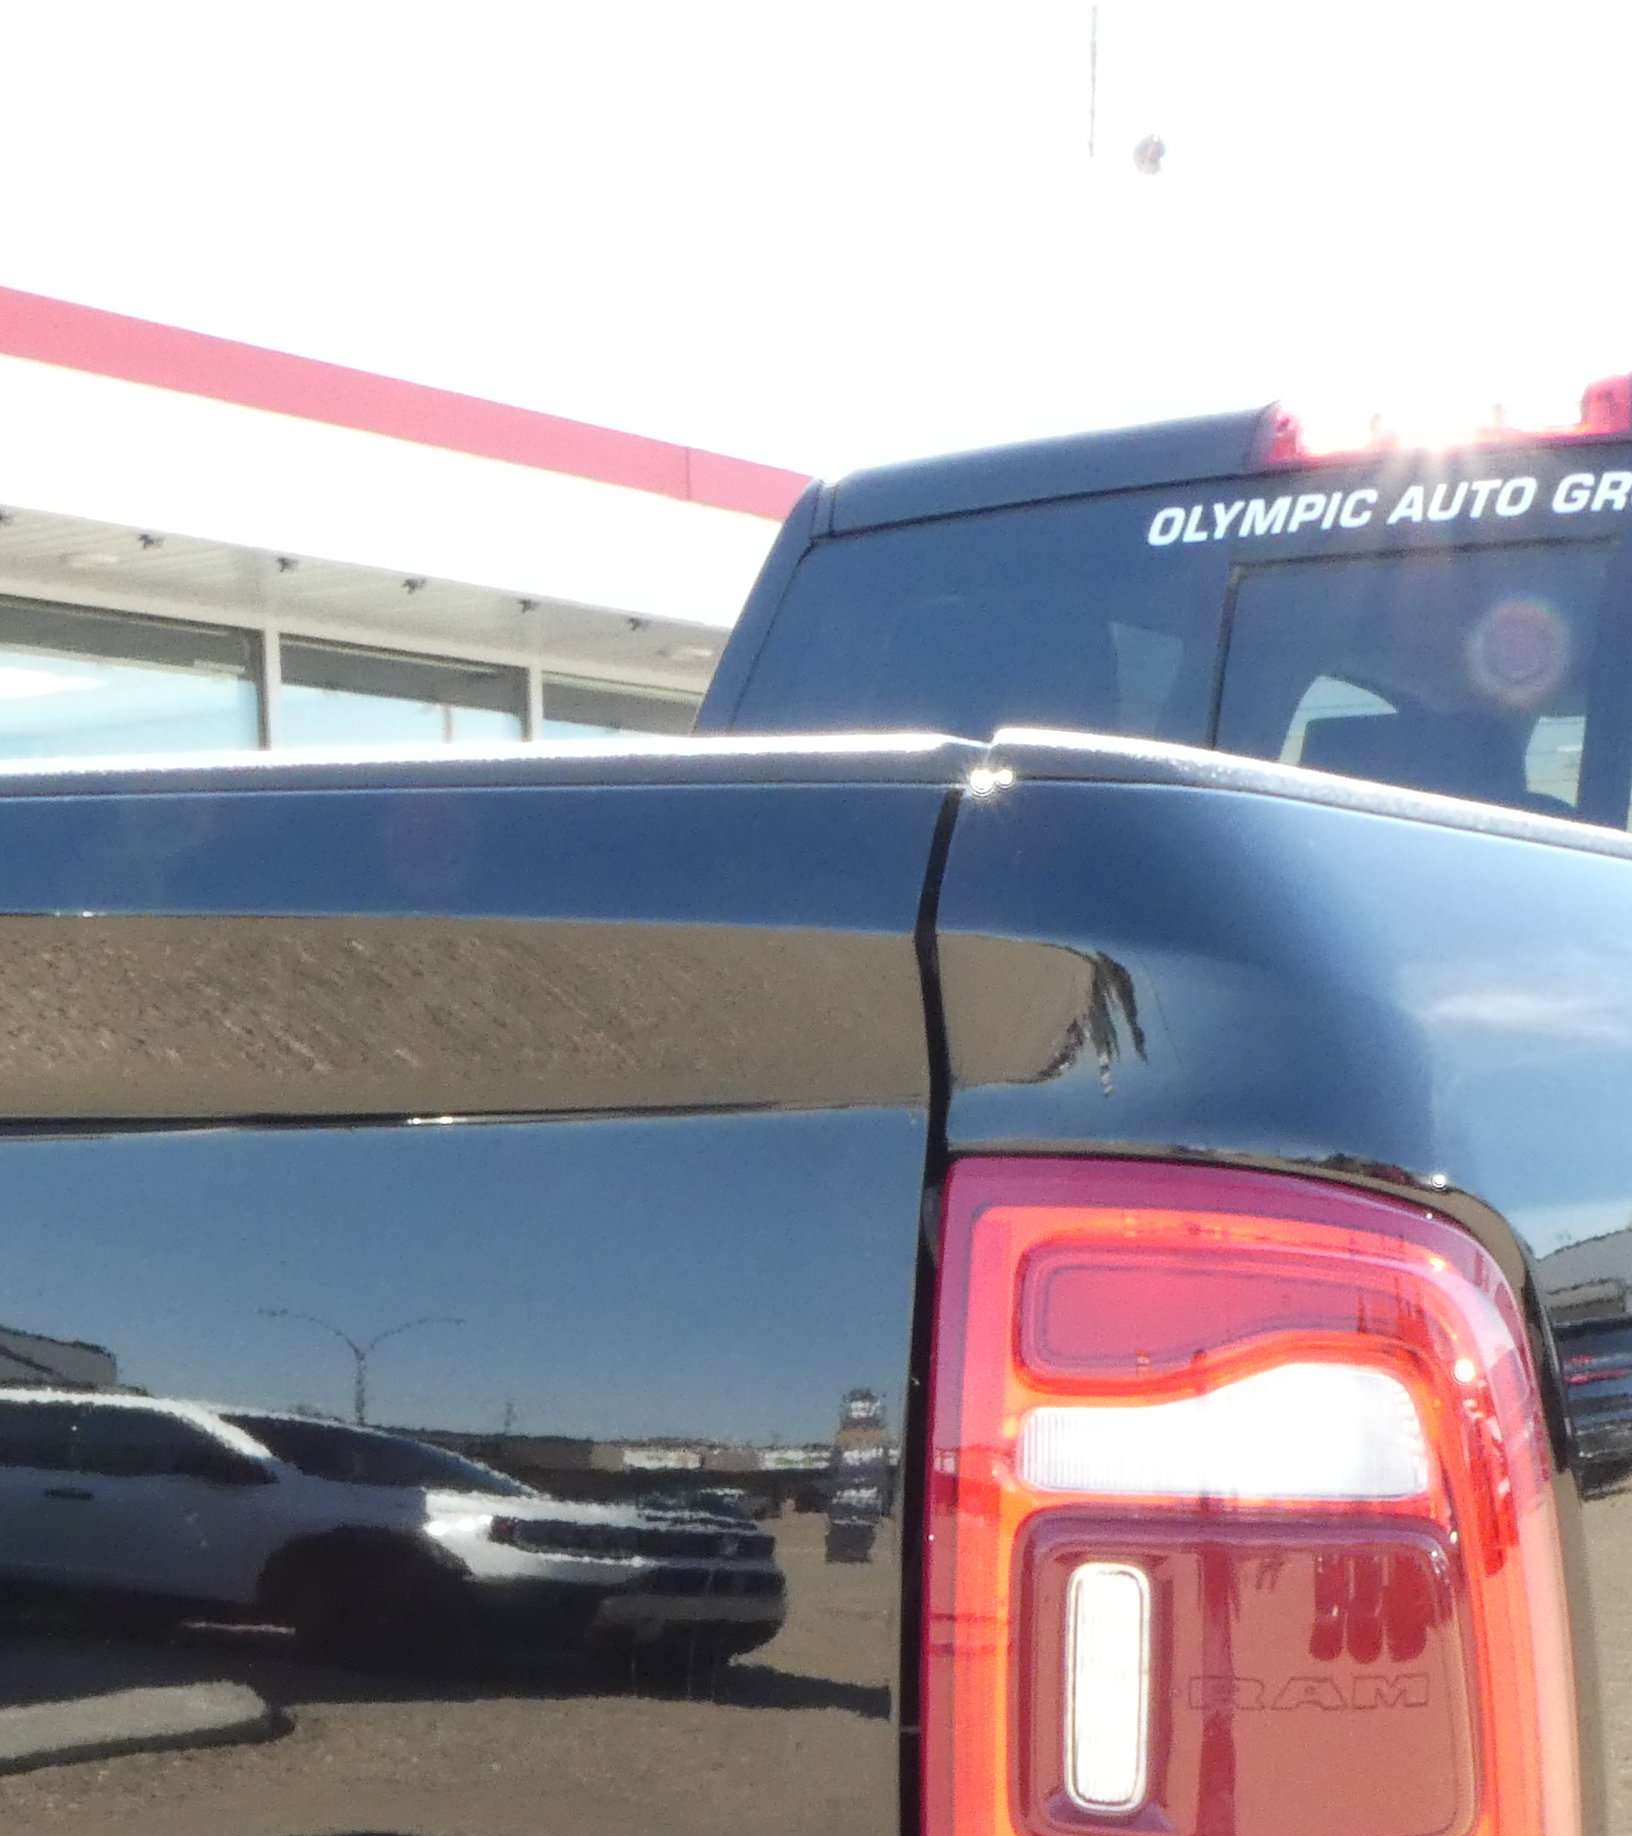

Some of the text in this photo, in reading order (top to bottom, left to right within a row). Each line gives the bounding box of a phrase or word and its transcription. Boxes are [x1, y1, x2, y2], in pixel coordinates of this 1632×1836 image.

[1147, 487, 1379, 547] OLYMPIC
[1387, 476, 1536, 526] AUTO
[1188, 1673, 1431, 1711] RAM
